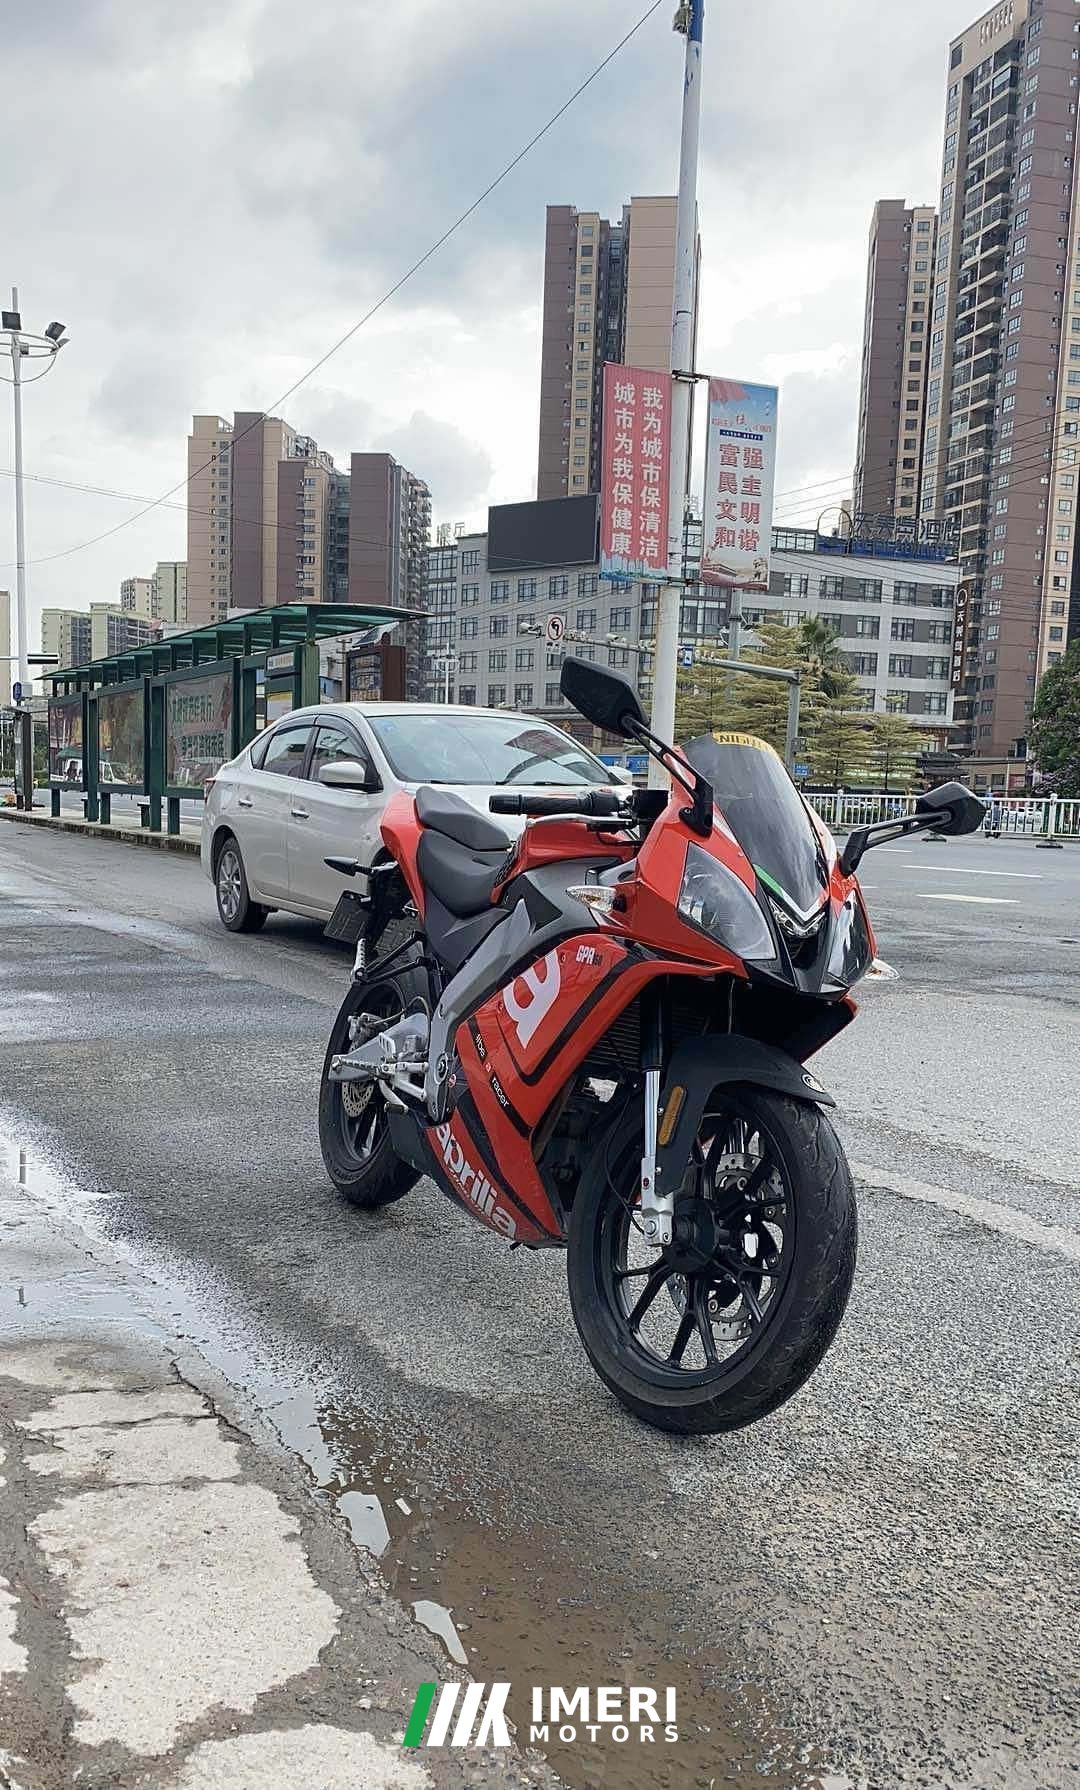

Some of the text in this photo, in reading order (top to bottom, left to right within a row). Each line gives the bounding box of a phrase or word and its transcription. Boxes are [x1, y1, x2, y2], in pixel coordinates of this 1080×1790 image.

[610, 382, 635, 554] 城市为我保健康
[719, 443, 764, 470] 富强
[640, 387, 664, 558] 我为城市保清洁
[718, 471, 762, 497] 民主
[716, 499, 760, 525] 文明
[714, 526, 759, 552] 和谐
[491, 1076, 510, 1108] racer
[436, 1122, 517, 1240] aprilia
